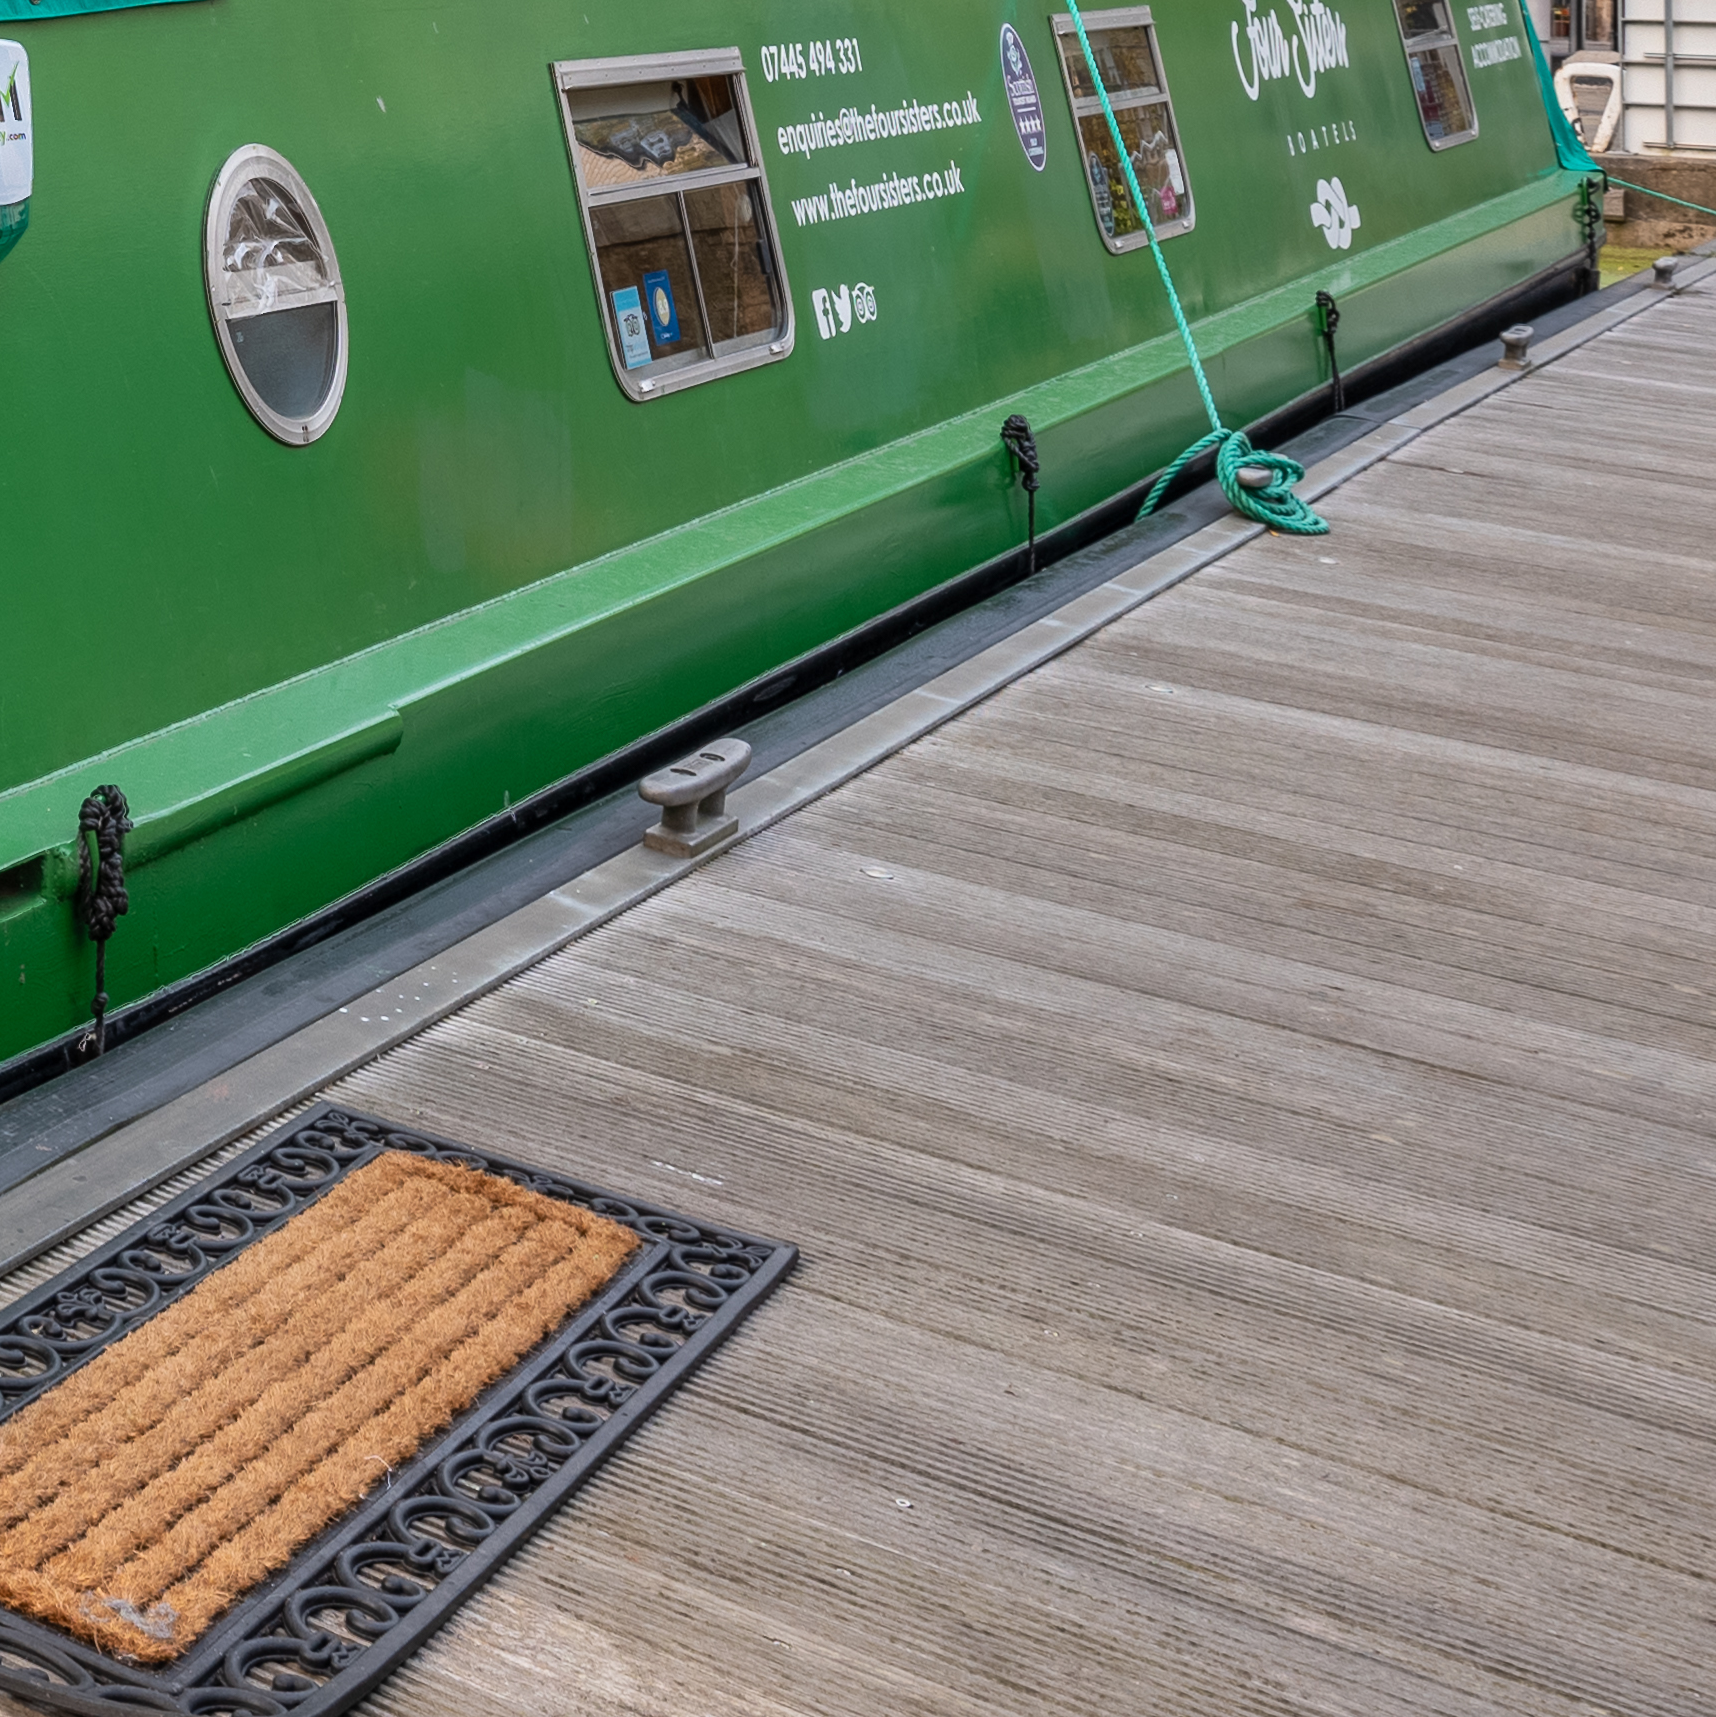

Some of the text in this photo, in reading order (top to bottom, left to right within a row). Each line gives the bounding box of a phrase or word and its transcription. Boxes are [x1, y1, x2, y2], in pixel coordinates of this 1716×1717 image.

[760, 37, 863, 83] 07445 494 331
[777, 90, 982, 160] enquiries@thefoursisters.co.uk
[1287, 120, 1357, 157] BOATELS
[790, 159, 965, 228] www.thefoursisters.co.uk
